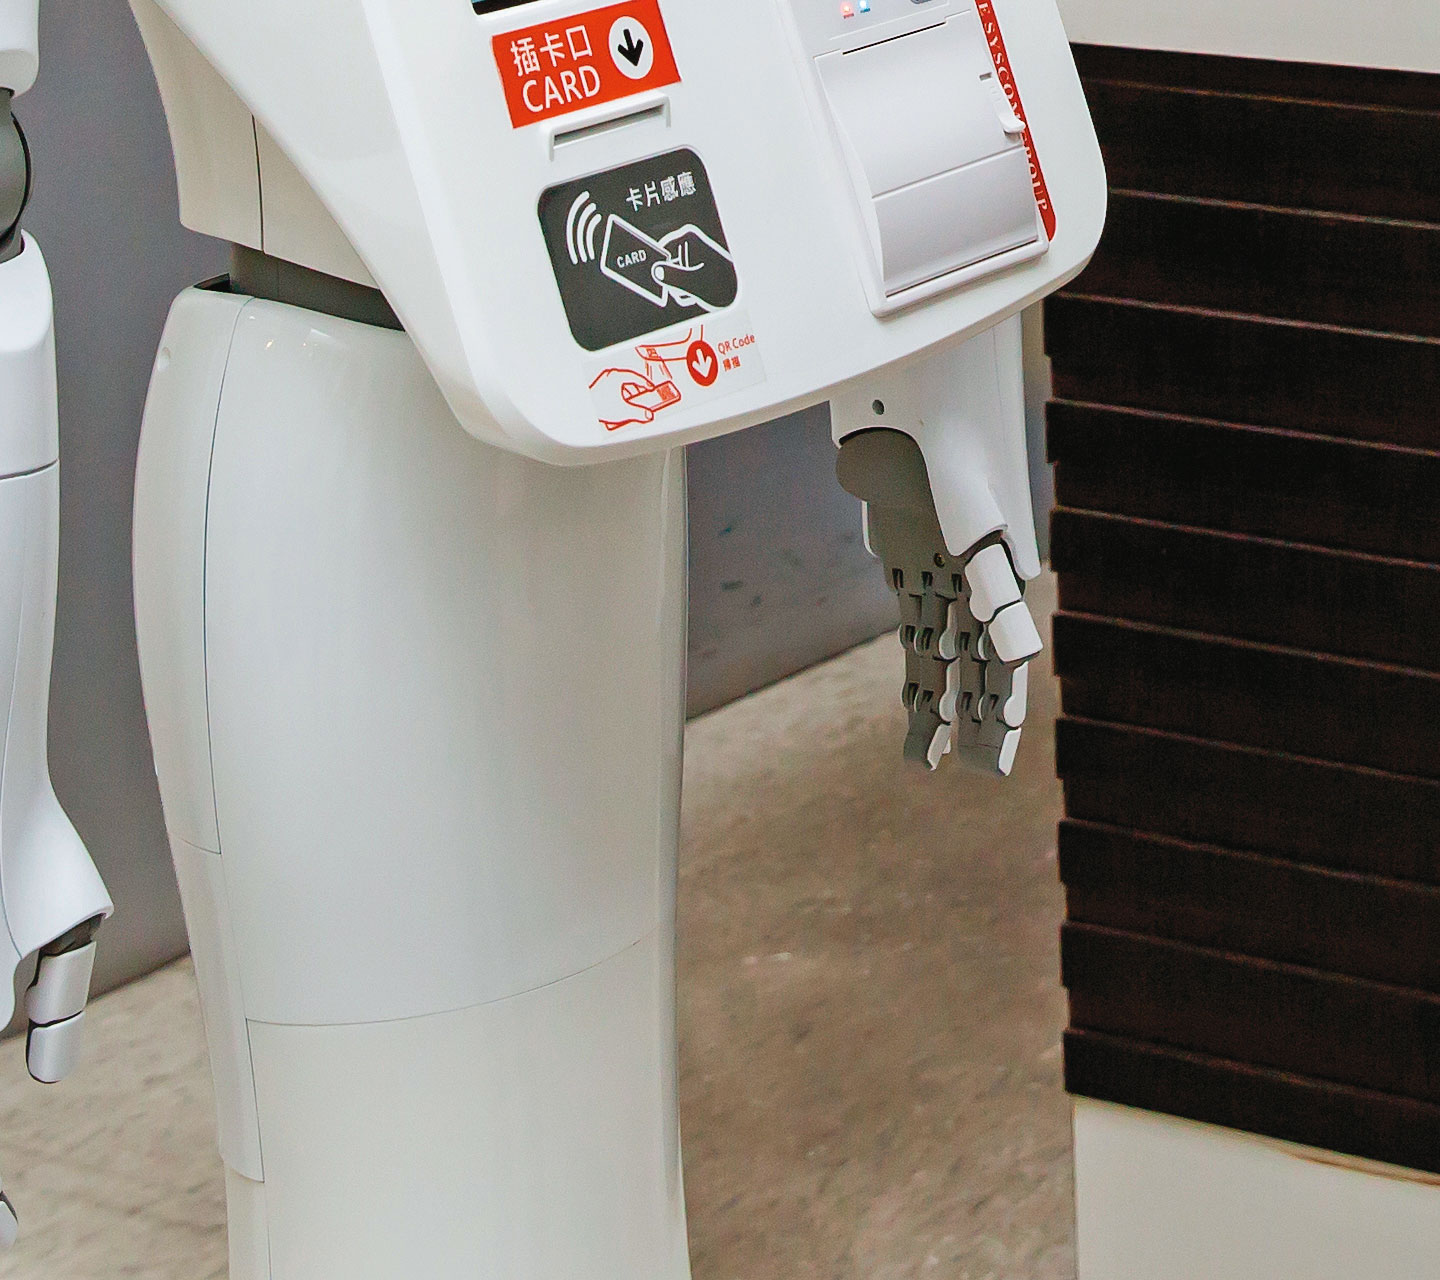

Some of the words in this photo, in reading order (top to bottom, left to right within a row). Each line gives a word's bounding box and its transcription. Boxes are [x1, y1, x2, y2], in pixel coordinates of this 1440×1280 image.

[510, 25, 593, 77] 插卡口
[522, 65, 601, 112] CARD
[626, 171, 697, 212] 卡片感應
[616, 249, 647, 268] CARD
[717, 341, 732, 355] QR
[732, 333, 756, 349] Code
